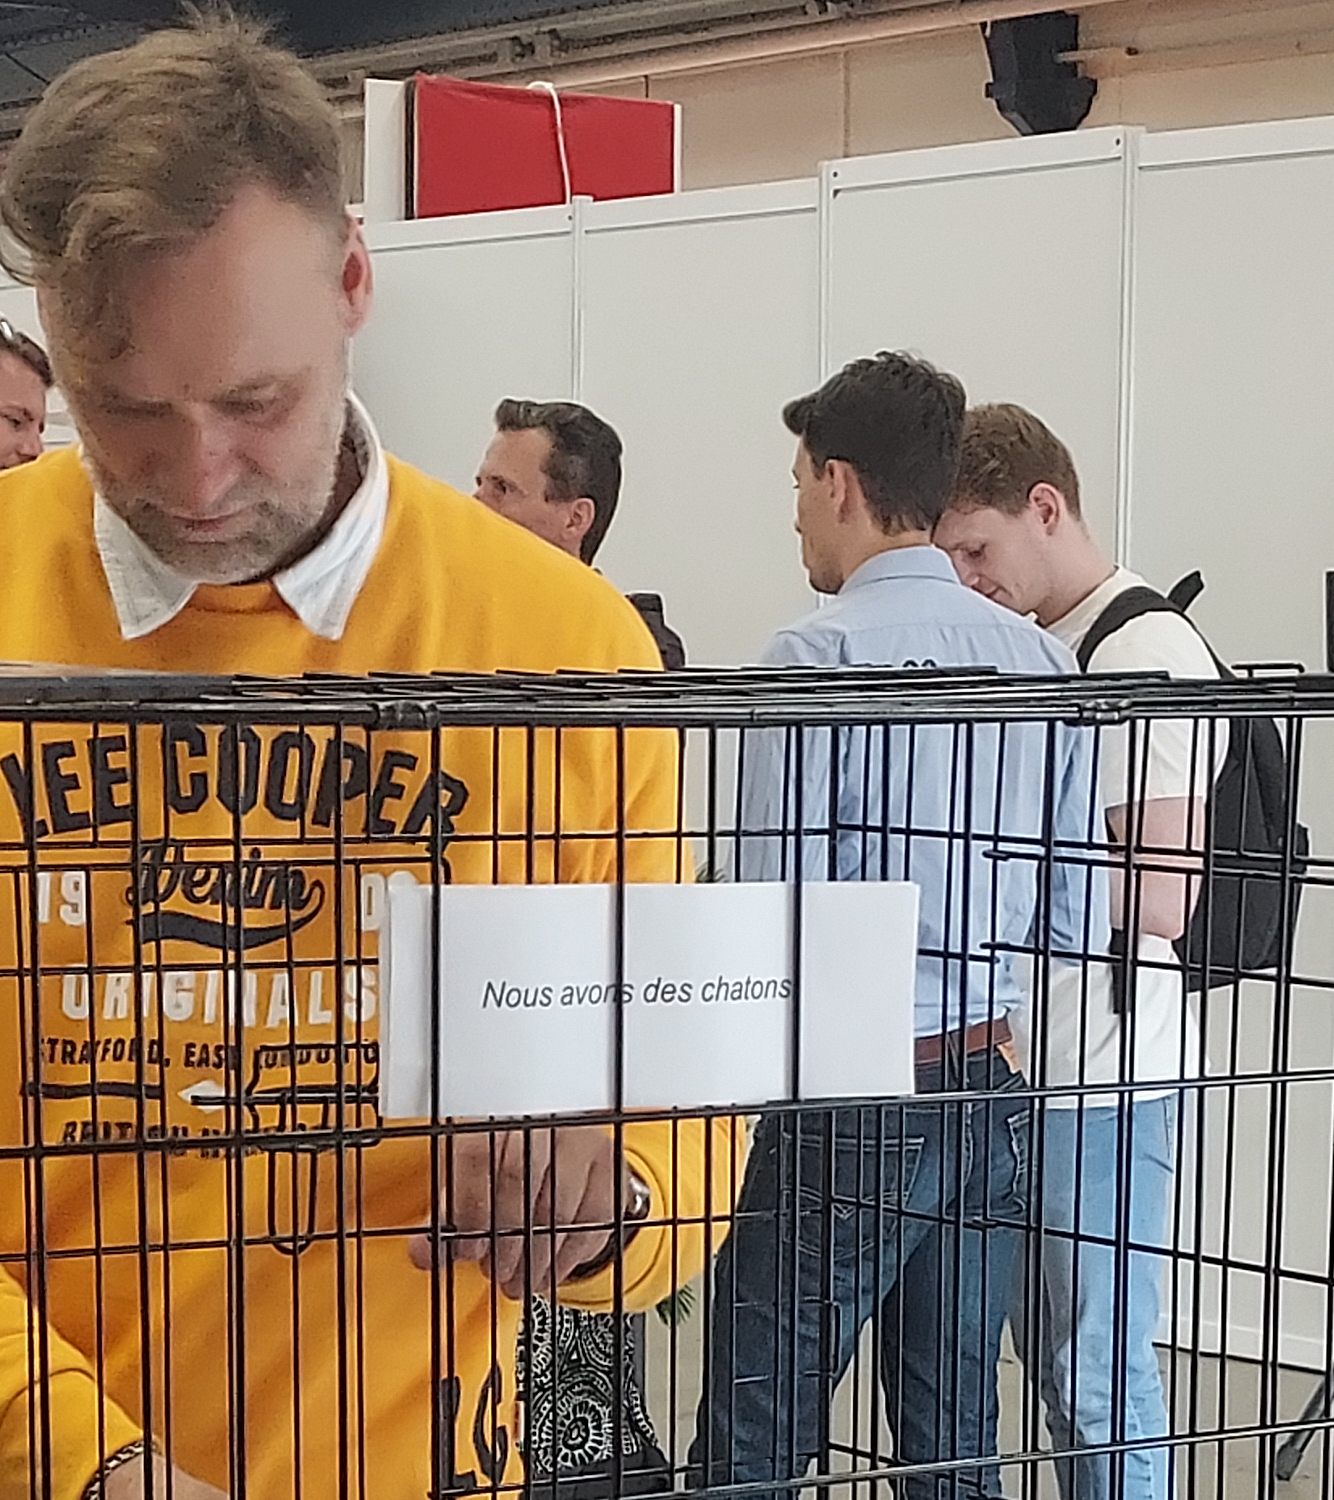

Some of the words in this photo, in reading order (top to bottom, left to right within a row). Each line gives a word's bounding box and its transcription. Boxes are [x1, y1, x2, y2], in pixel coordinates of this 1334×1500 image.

[0, 735, 133, 838] LEE
[167, 724, 470, 842] COOPER
[125, 839, 325, 912] Denim
[62, 966, 378, 1029] ORIGINALS
[481, 981, 554, 1010] Nous
[560, 982, 634, 1007] avons
[643, 977, 694, 1004] des
[700, 975, 793, 1003] chatons
